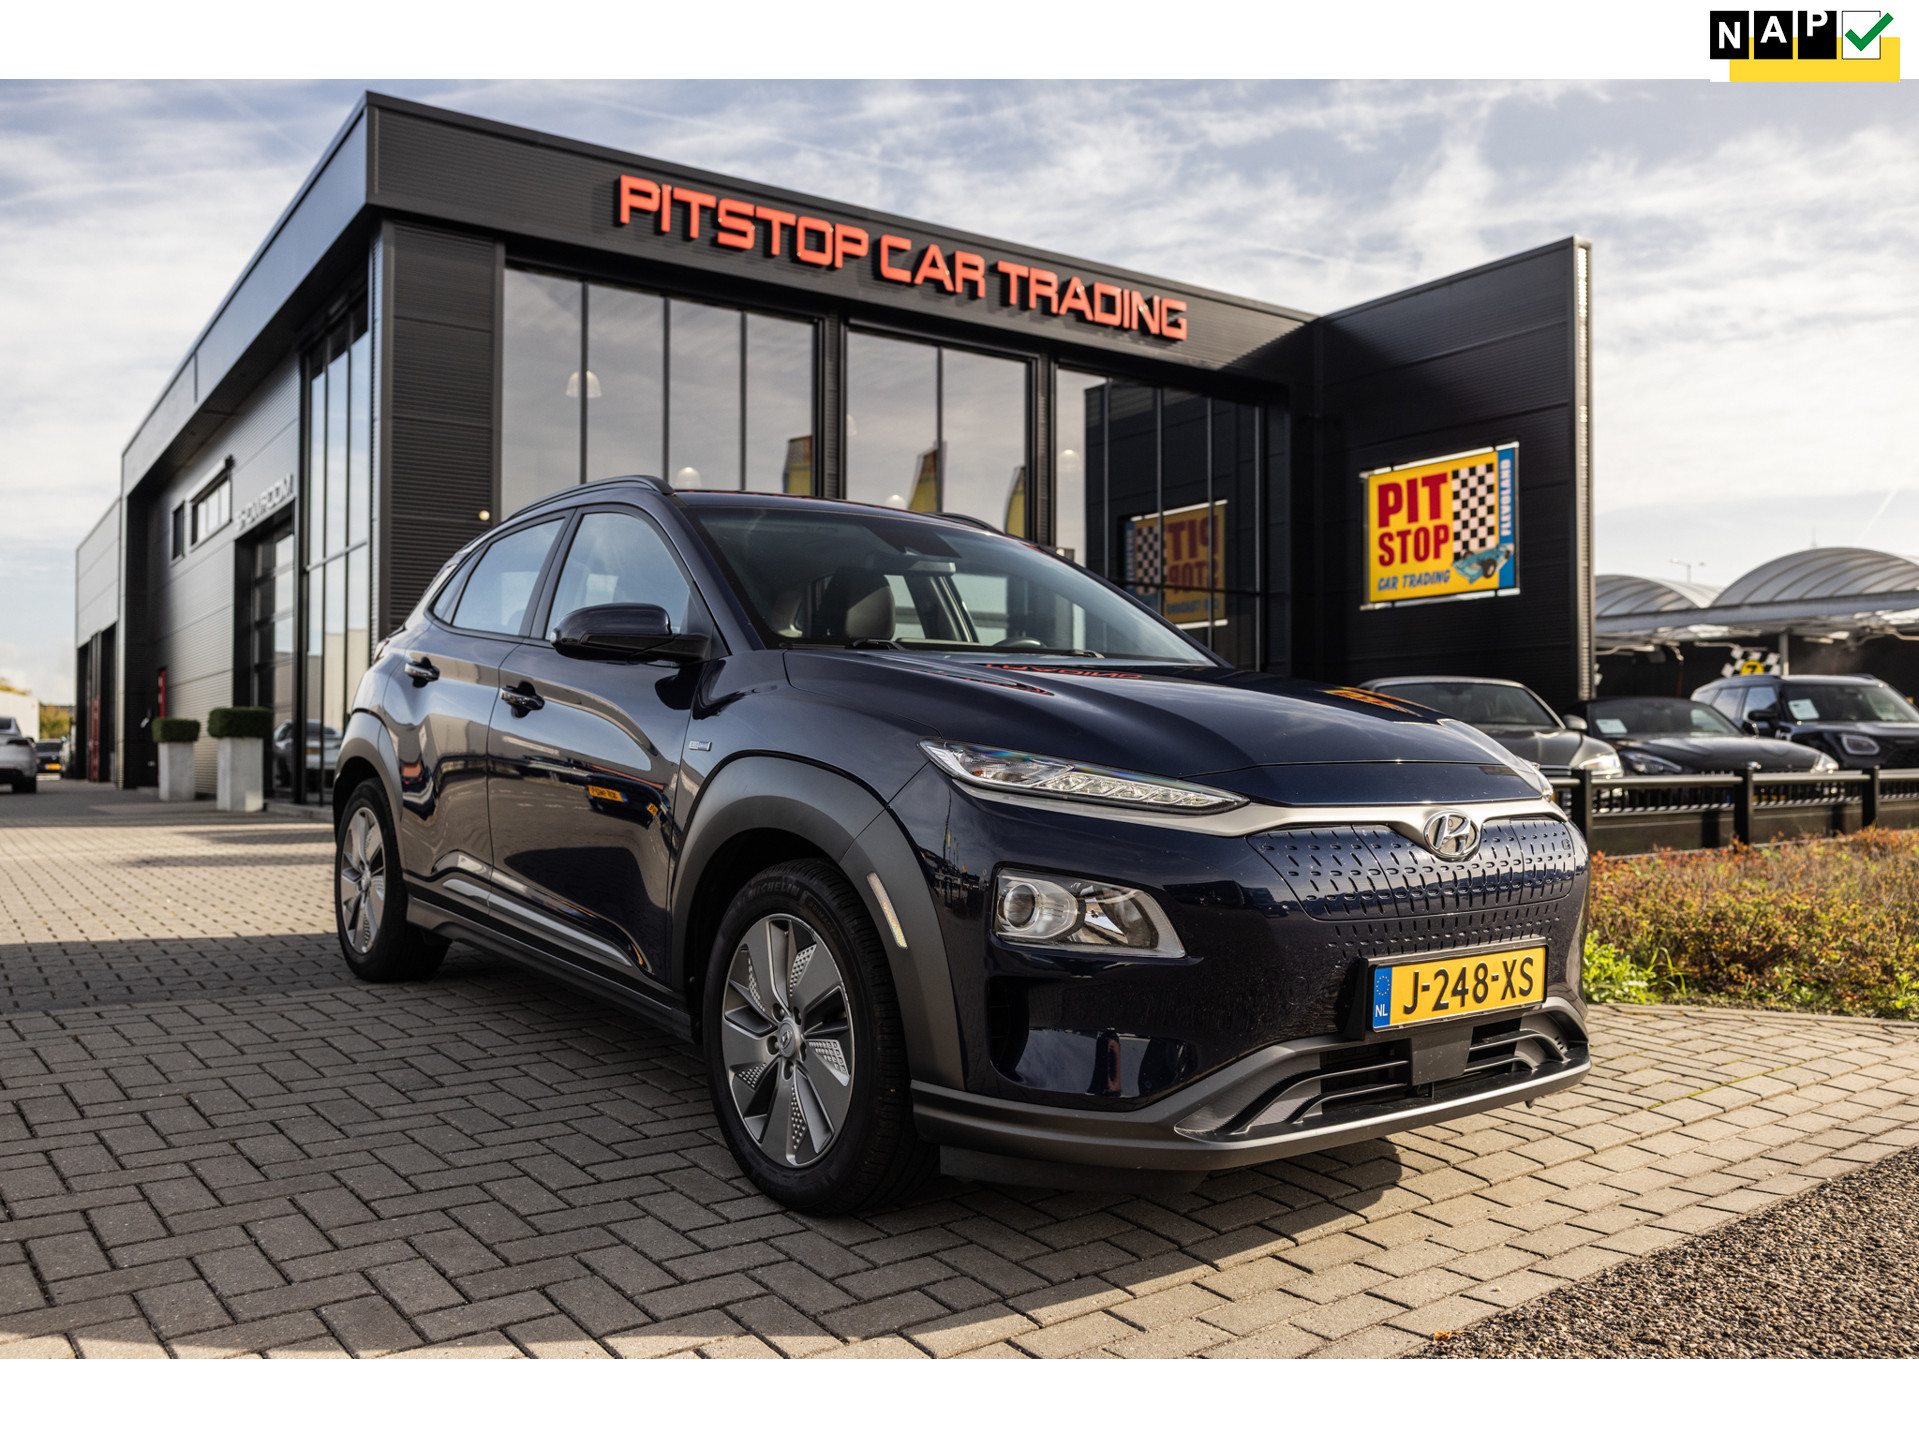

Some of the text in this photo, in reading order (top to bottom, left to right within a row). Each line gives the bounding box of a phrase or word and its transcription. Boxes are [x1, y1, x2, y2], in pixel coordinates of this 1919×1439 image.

[620, 174, 1188, 341] PITSTOP CAR TRADING
[1378, 472, 1448, 528] PIT
[1500, 459, 1511, 537] FLEVOLAND
[1378, 524, 1450, 567] STOP
[1377, 569, 1451, 591] CAR TRADING
[1375, 1003, 1388, 1018] NL
[1403, 956, 1534, 1015] J-248-XS
